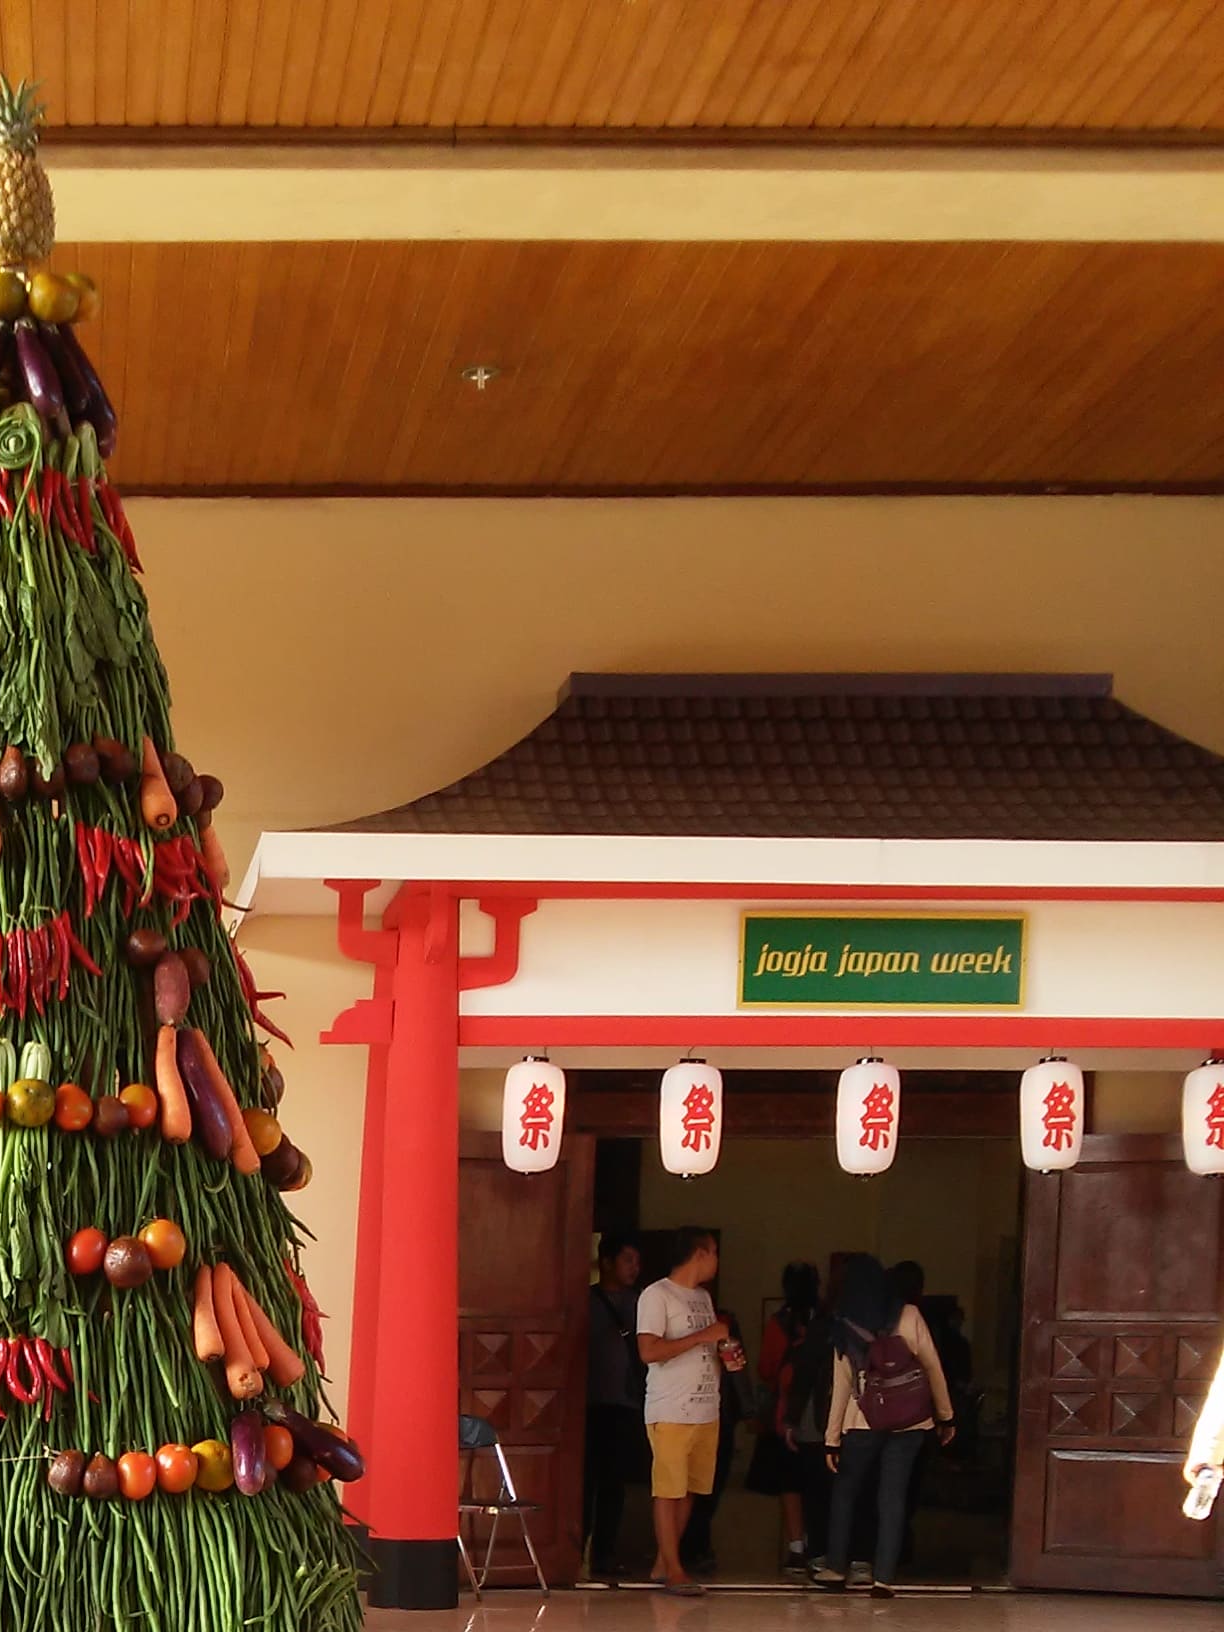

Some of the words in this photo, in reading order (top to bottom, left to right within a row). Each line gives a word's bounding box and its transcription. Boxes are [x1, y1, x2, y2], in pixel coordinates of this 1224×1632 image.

[753, 944, 827, 977] jogja
[834, 944, 920, 977] japan
[930, 946, 1012, 974] week
[519, 1083, 555, 1151] 祭
[681, 1084, 716, 1152] 祭
[859, 1082, 895, 1151] 祭
[1041, 1081, 1077, 1151] 祭
